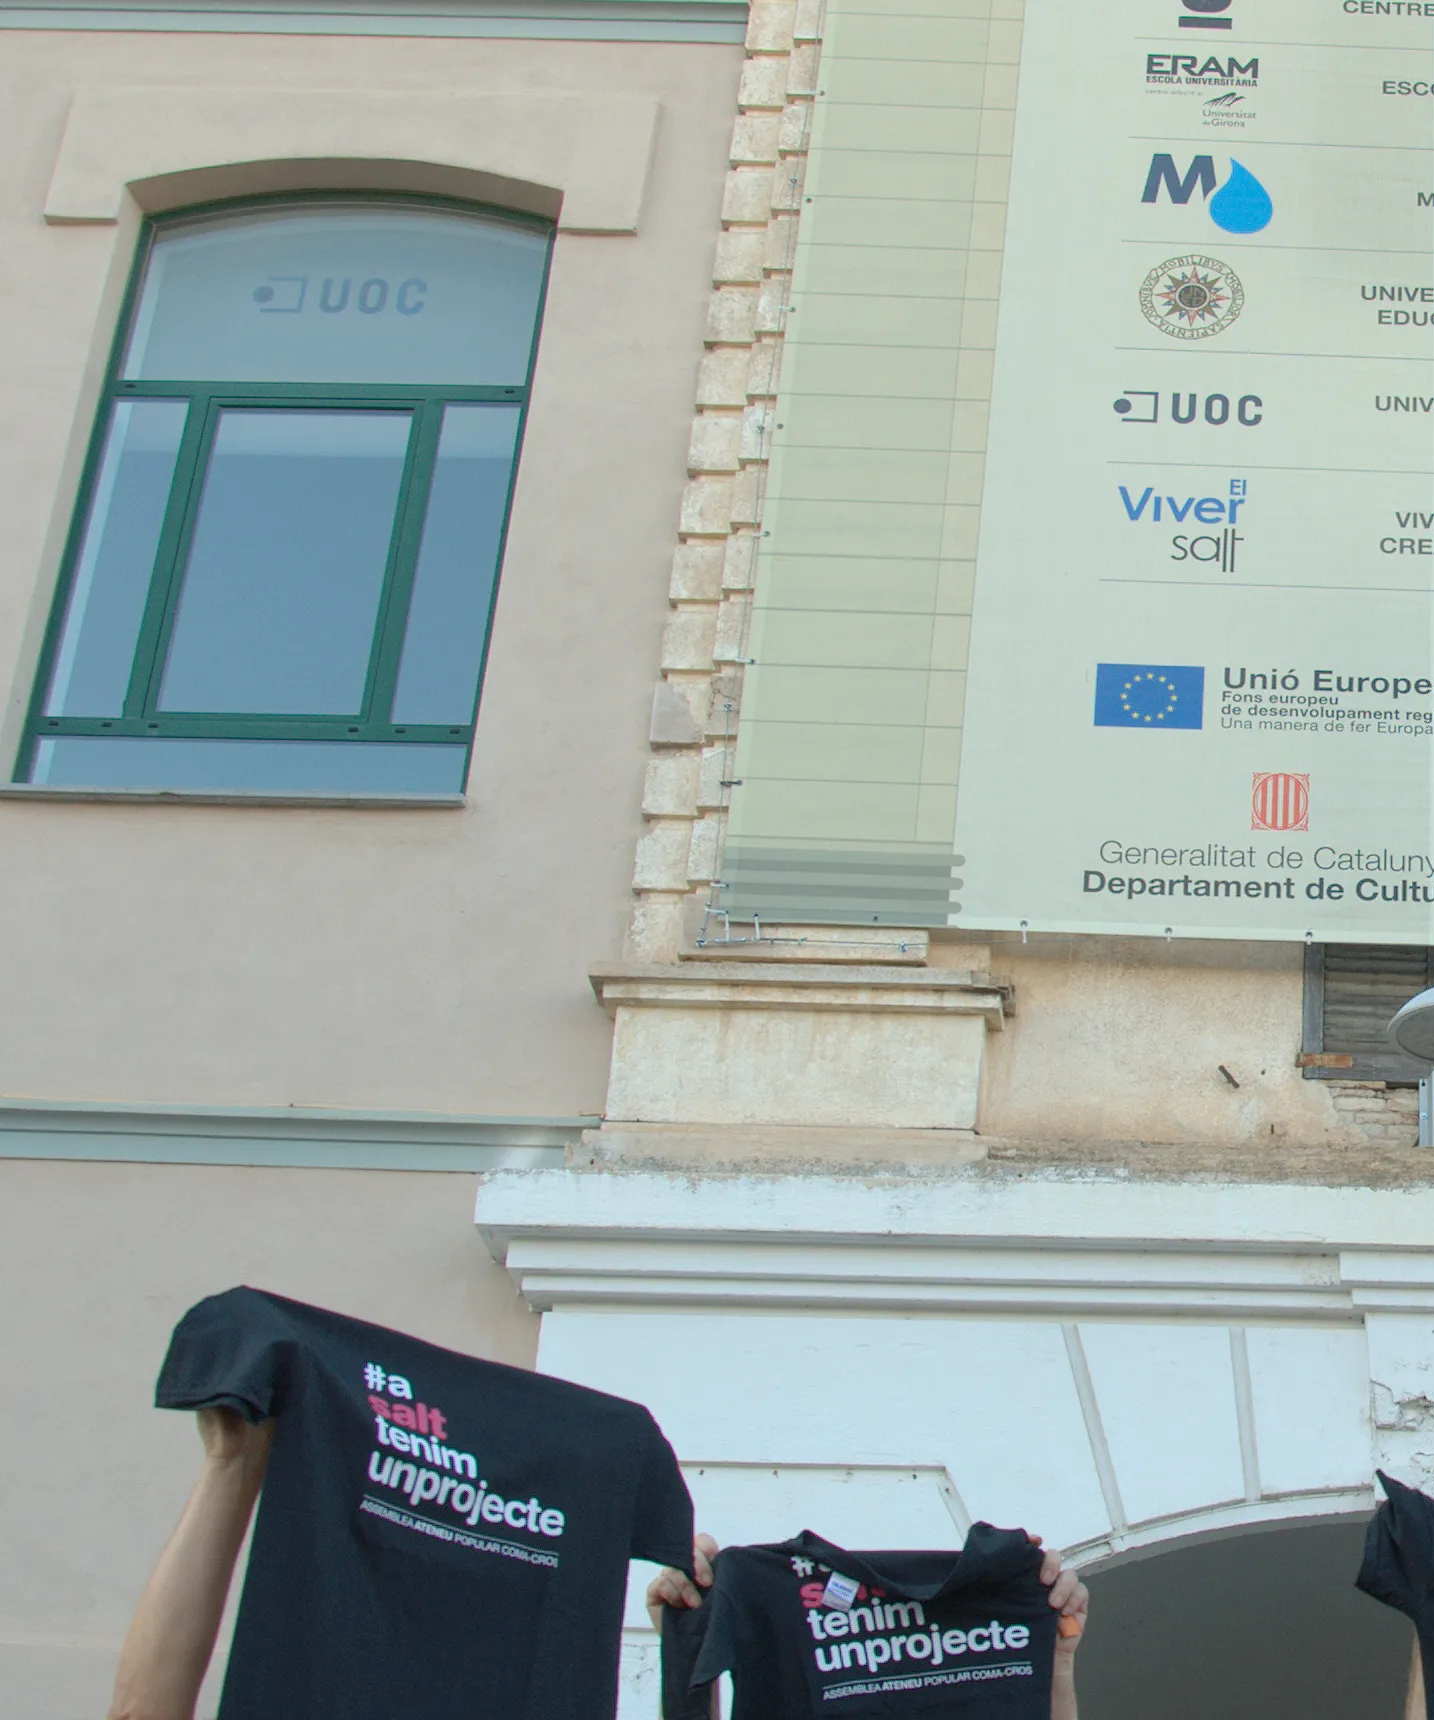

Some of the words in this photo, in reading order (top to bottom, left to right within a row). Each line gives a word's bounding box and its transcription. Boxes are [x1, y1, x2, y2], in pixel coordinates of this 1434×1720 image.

[1146, 76, 1182, 85] ESCOLA
[1185, 76, 1258, 87] UNIVERSITÀRIA
[1147, 54, 1259, 78] ERAM
[319, 277, 428, 316] UOC
[1172, 392, 1262, 426] UOC
[1118, 486, 1245, 524] Viver
[1171, 528, 1244, 572] salt
[1224, 667, 1299, 690] Unió
[1221, 704, 1242, 716] de
[1248, 705, 1400, 721] desenvolupament
[1222, 691, 1263, 703] Fons
[1269, 694, 1339, 707] europeu
[1221, 717, 1252, 729] Una
[1259, 719, 1318, 732] manera
[1324, 720, 1344, 732] de
[1350, 720, 1371, 733] fer
[1377, 721, 1434, 737] Europa
[1099, 840, 1256, 868] Generalitat
[1267, 846, 1303, 870] de
[1083, 870, 1294, 900] Departament
[1305, 877, 1344, 900] de
[363, 1361, 413, 1400] #a
[367, 1394, 447, 1440] salt
[375, 1414, 478, 1479] tenim
[368, 1451, 565, 1537] unprojecte
[807, 1598, 925, 1640] tenim
[815, 1620, 1030, 1672] unprojecte
[881, 1678, 923, 1692] ATENEU
[924, 1671, 971, 1687] POPULAR
